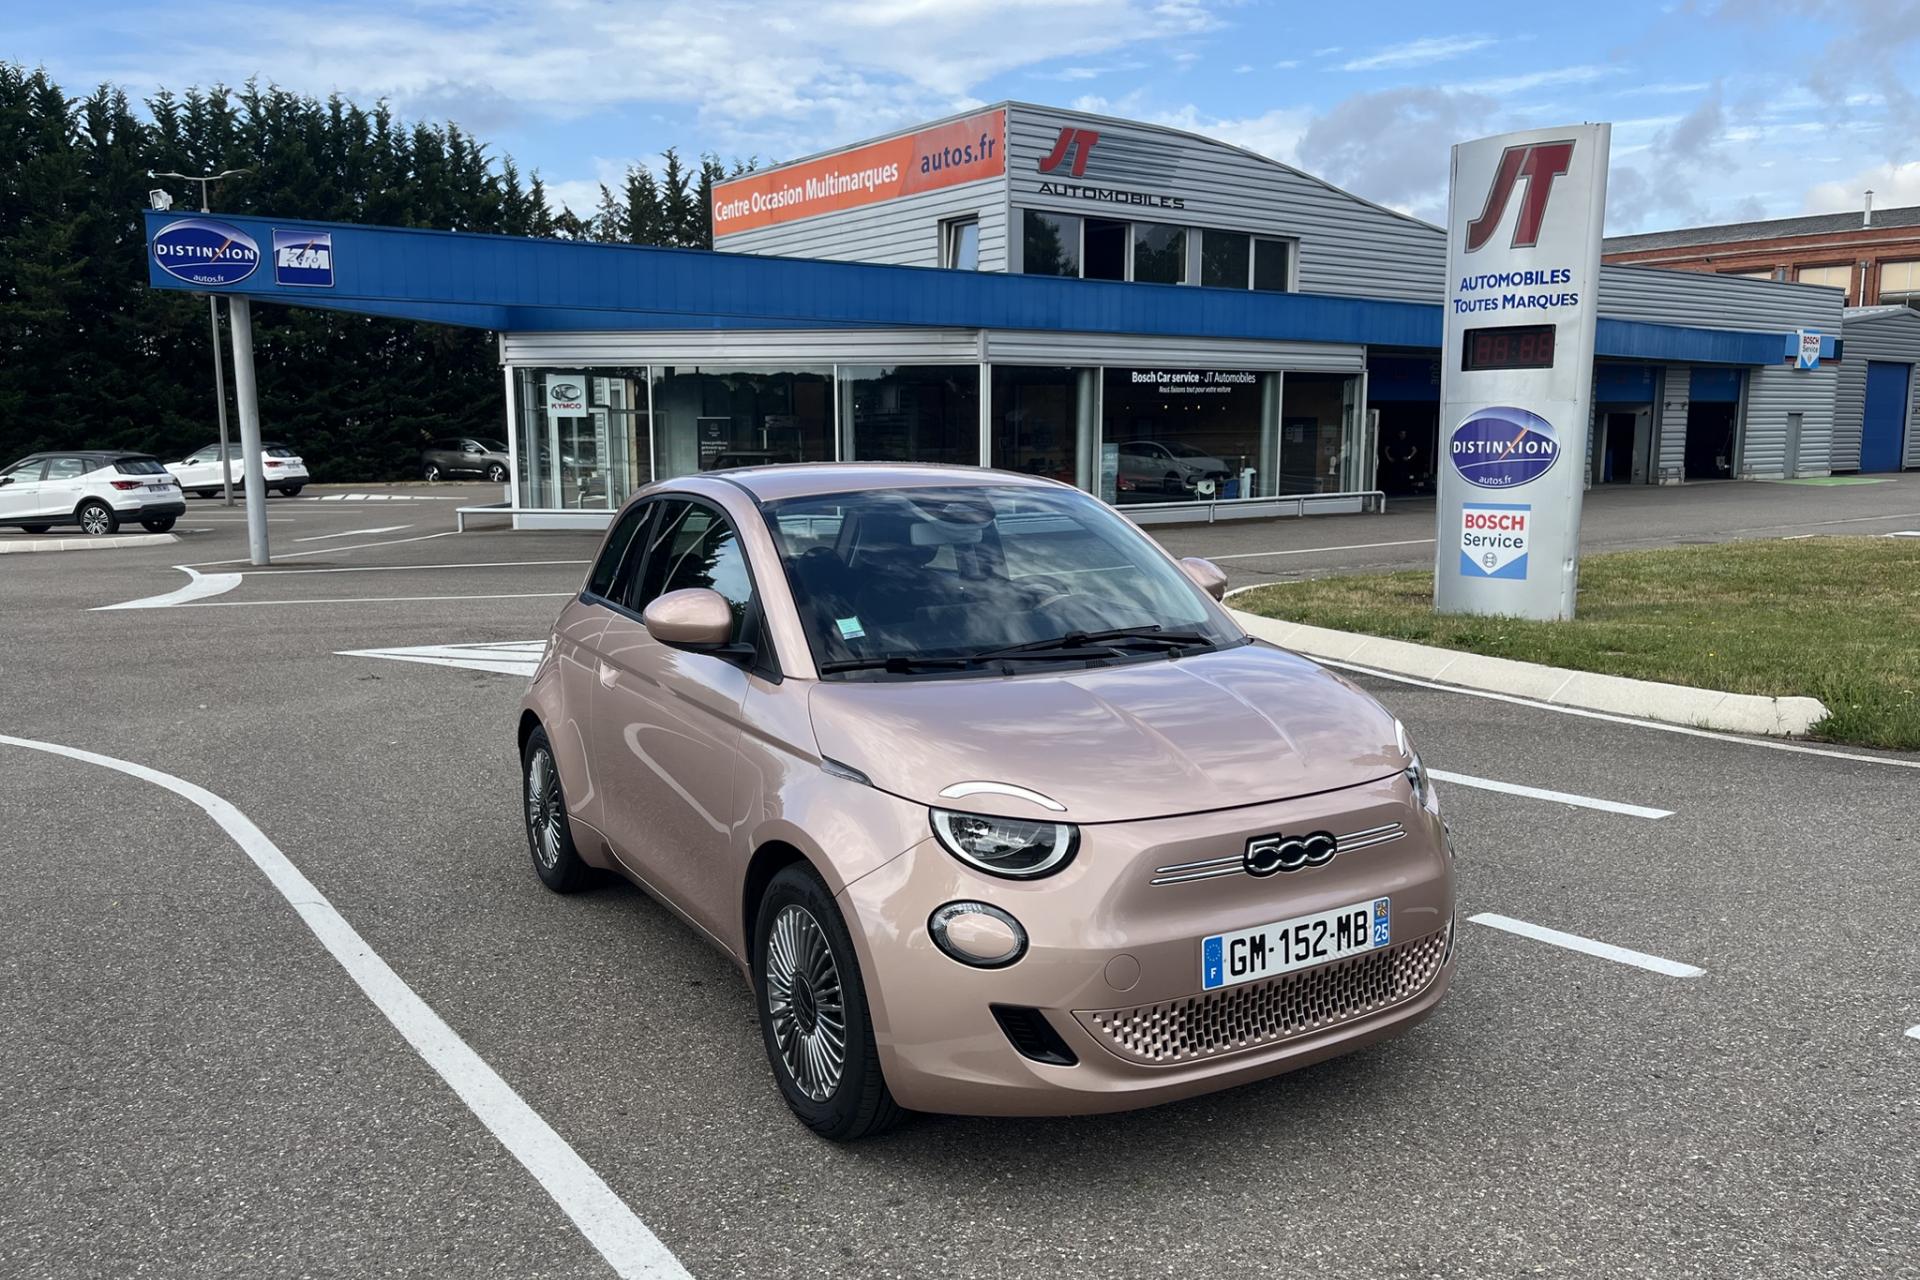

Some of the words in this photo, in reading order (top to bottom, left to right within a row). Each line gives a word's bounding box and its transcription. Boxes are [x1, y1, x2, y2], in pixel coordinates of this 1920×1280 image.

[921, 133, 996, 173] autos.fr
[1038, 126, 1100, 178] JT
[714, 200, 750, 221] Centre
[751, 184, 803, 213] Occasion
[805, 162, 899, 202] Multimarques
[1038, 182, 1185, 209] AUTOMOBILES
[1464, 139, 1577, 253] JT
[156, 244, 255, 260] DISTINXION
[193, 274, 225, 282] autos.fr
[1460, 269, 1571, 292] AUTOMOBILES
[1803, 336, 1820, 344] BOSCH
[1132, 371, 1156, 383] Bosch
[1157, 371, 1171, 383] Car
[1171, 371, 1200, 383] service
[1204, 372, 1213, 383] JT
[1214, 372, 1256, 383] Automobiles
[1453, 441, 1553, 454] DISTINXION
[1479, 475, 1512, 485] autos.fr
[1465, 514, 1525, 531] BOSCH
[1463, 533, 1524, 549] Service
[1245, 834, 1336, 875] 500
[1210, 967, 1217, 979] F
[1229, 910, 1369, 976] GM-152-MB
[1375, 923, 1388, 942] 25
